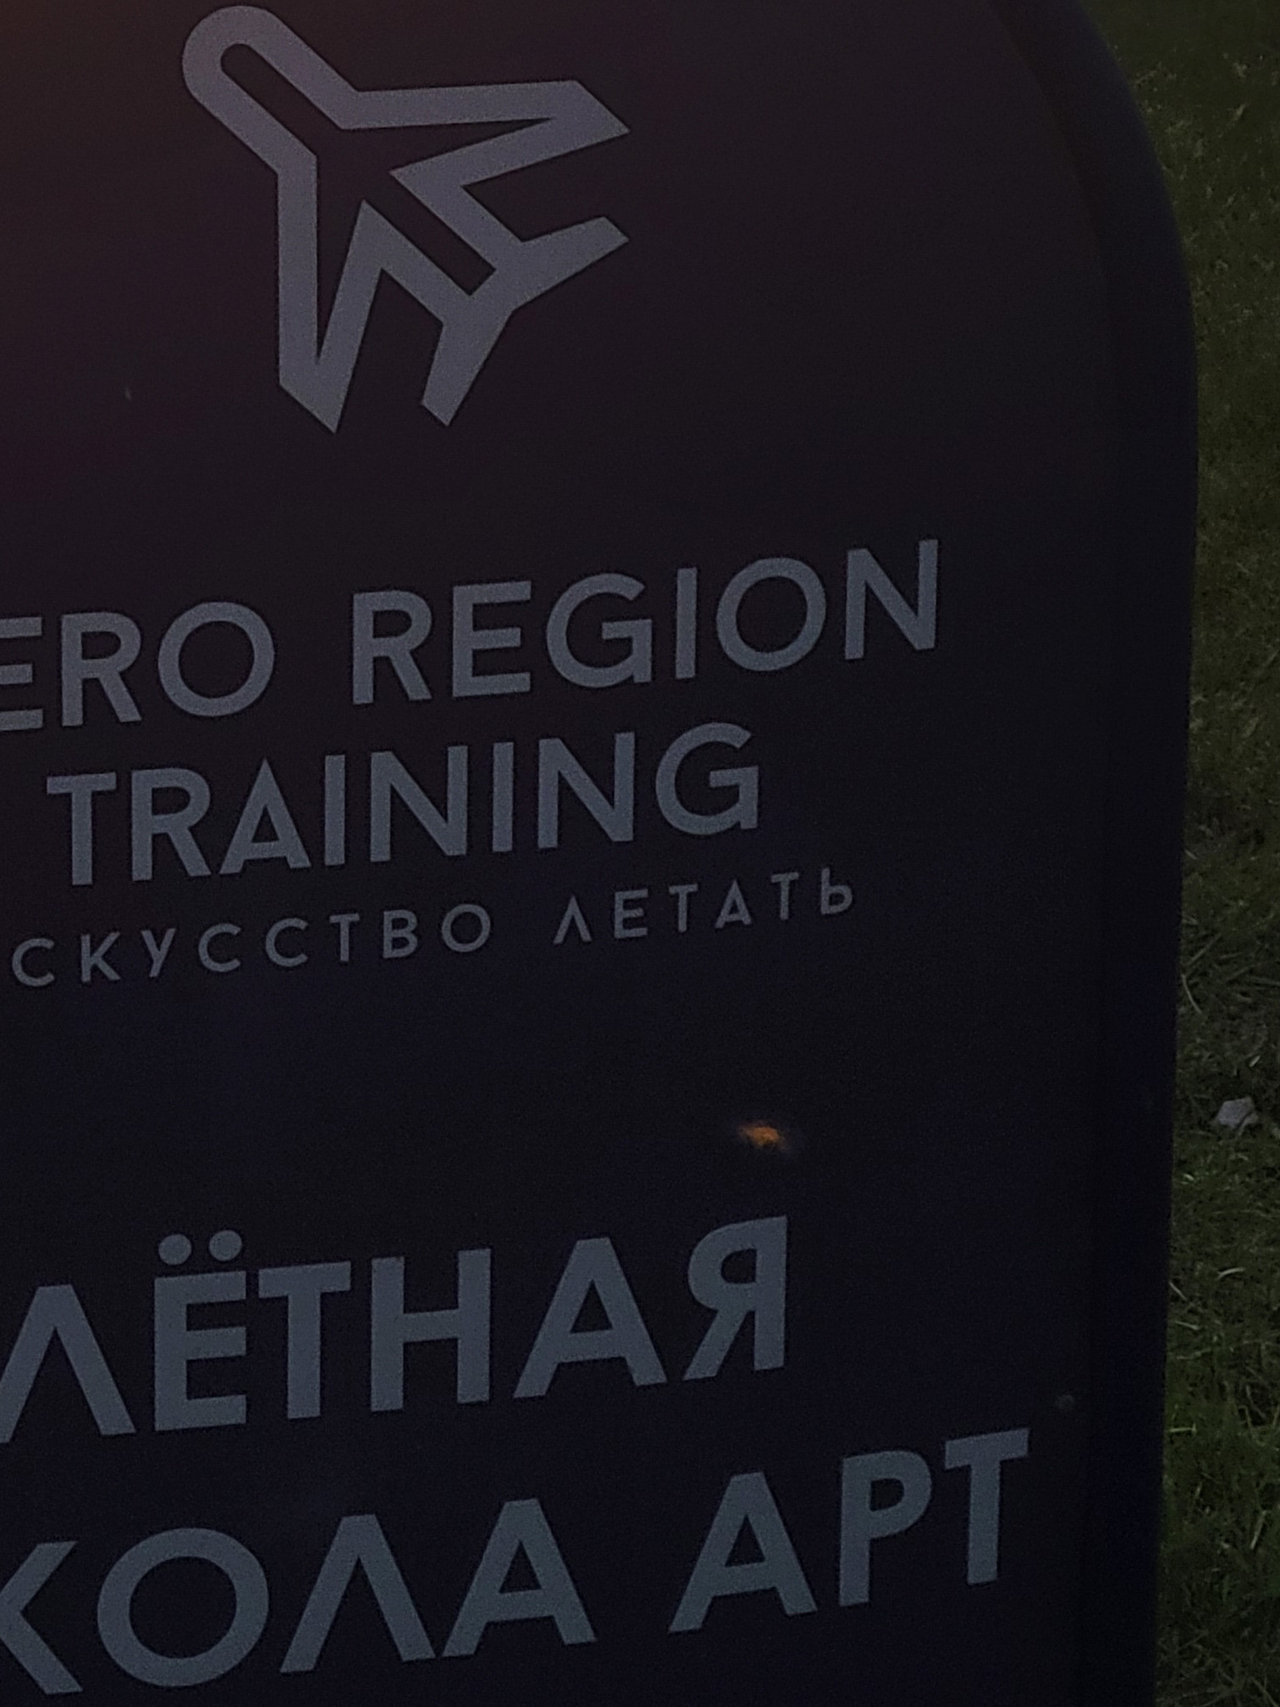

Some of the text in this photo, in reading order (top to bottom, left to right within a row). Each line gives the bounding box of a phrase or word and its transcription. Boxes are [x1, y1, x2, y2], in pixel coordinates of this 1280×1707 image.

[354, 541, 936, 703] REGION
[48, 724, 757, 883] TRAINING
[555, 869, 851, 943] ЛЕТАТЬ
[669, 1430, 1028, 1630] АРТ
